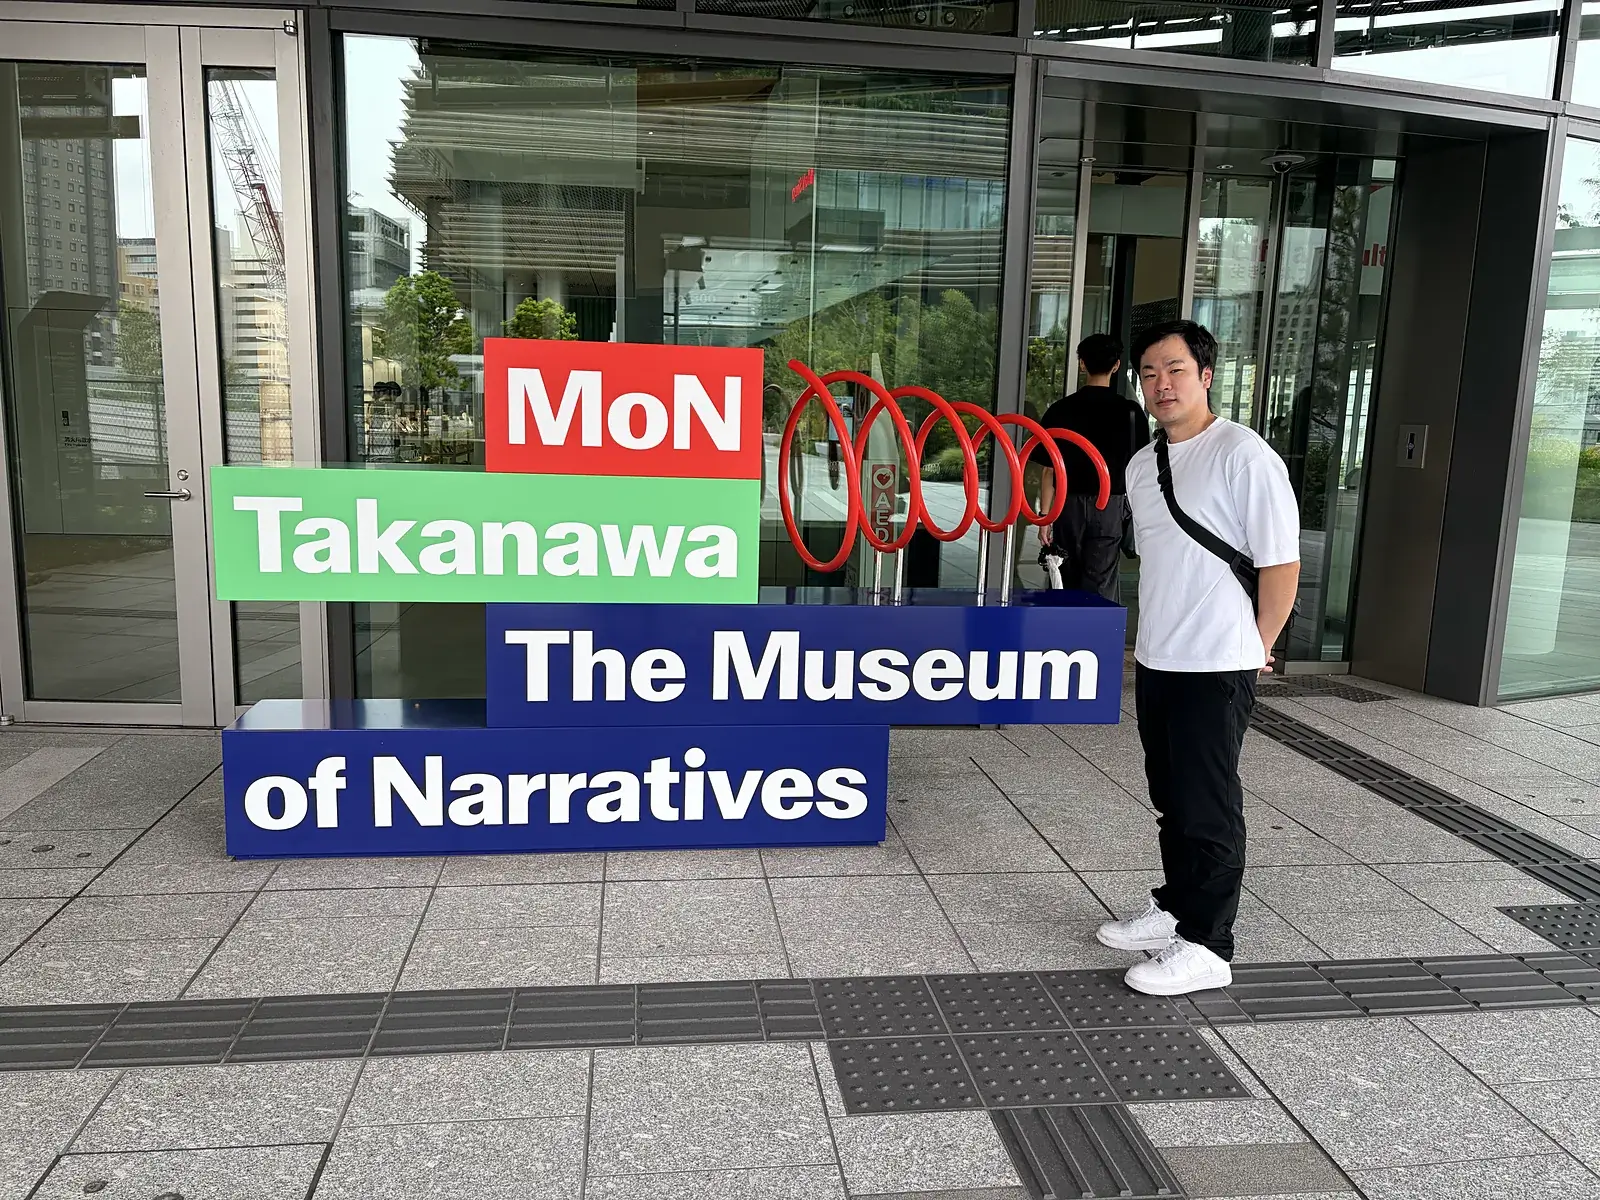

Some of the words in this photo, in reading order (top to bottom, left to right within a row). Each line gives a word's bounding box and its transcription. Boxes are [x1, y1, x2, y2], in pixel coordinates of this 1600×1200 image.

[507, 367, 742, 452] MoN
[233, 496, 738, 579] Takanawa
[874, 492, 891, 543] AED
[504, 630, 686, 702] The
[712, 630, 1099, 701] Museum
[244, 756, 347, 831] of
[373, 747, 868, 827] Narratives
